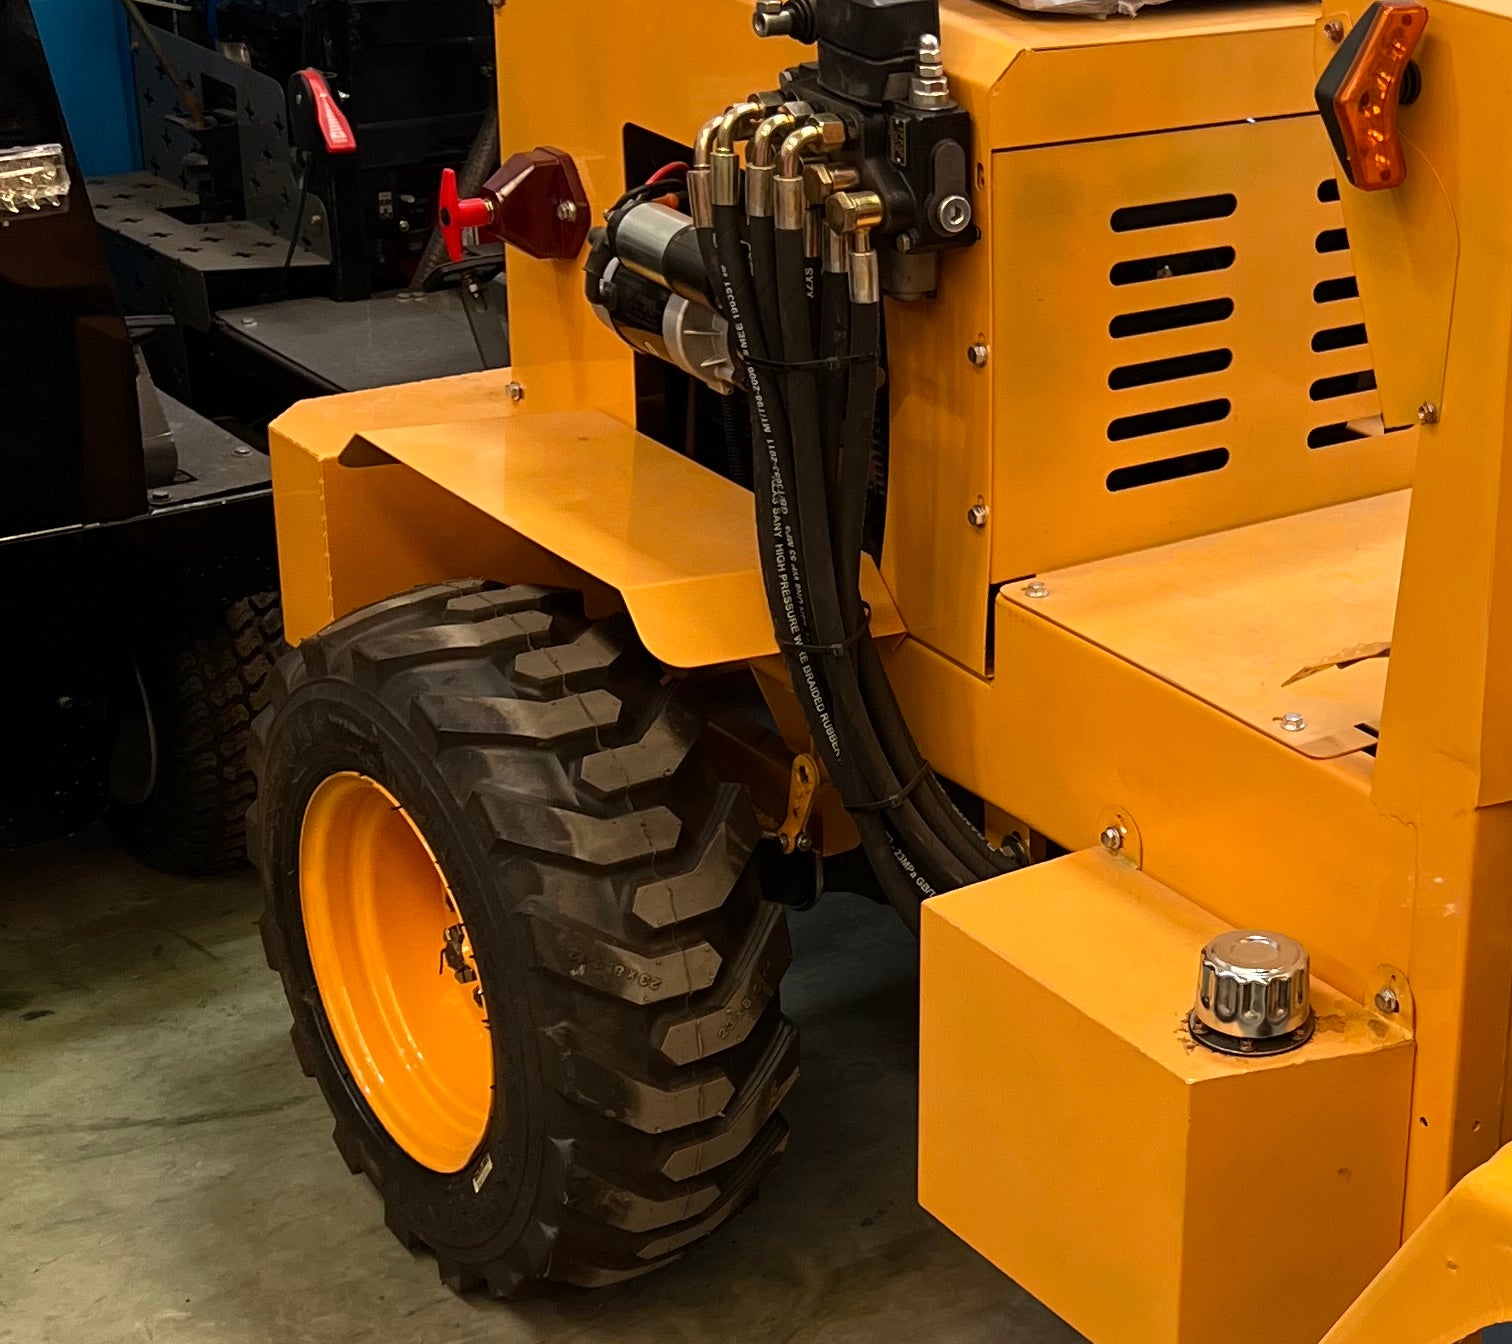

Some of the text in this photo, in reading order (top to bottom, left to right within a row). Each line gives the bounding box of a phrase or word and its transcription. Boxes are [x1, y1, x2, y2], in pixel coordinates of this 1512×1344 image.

[775, 543, 786, 572] HIGH
[779, 574, 800, 634] PRESSURE
[802, 664, 825, 713] BRAIDED
